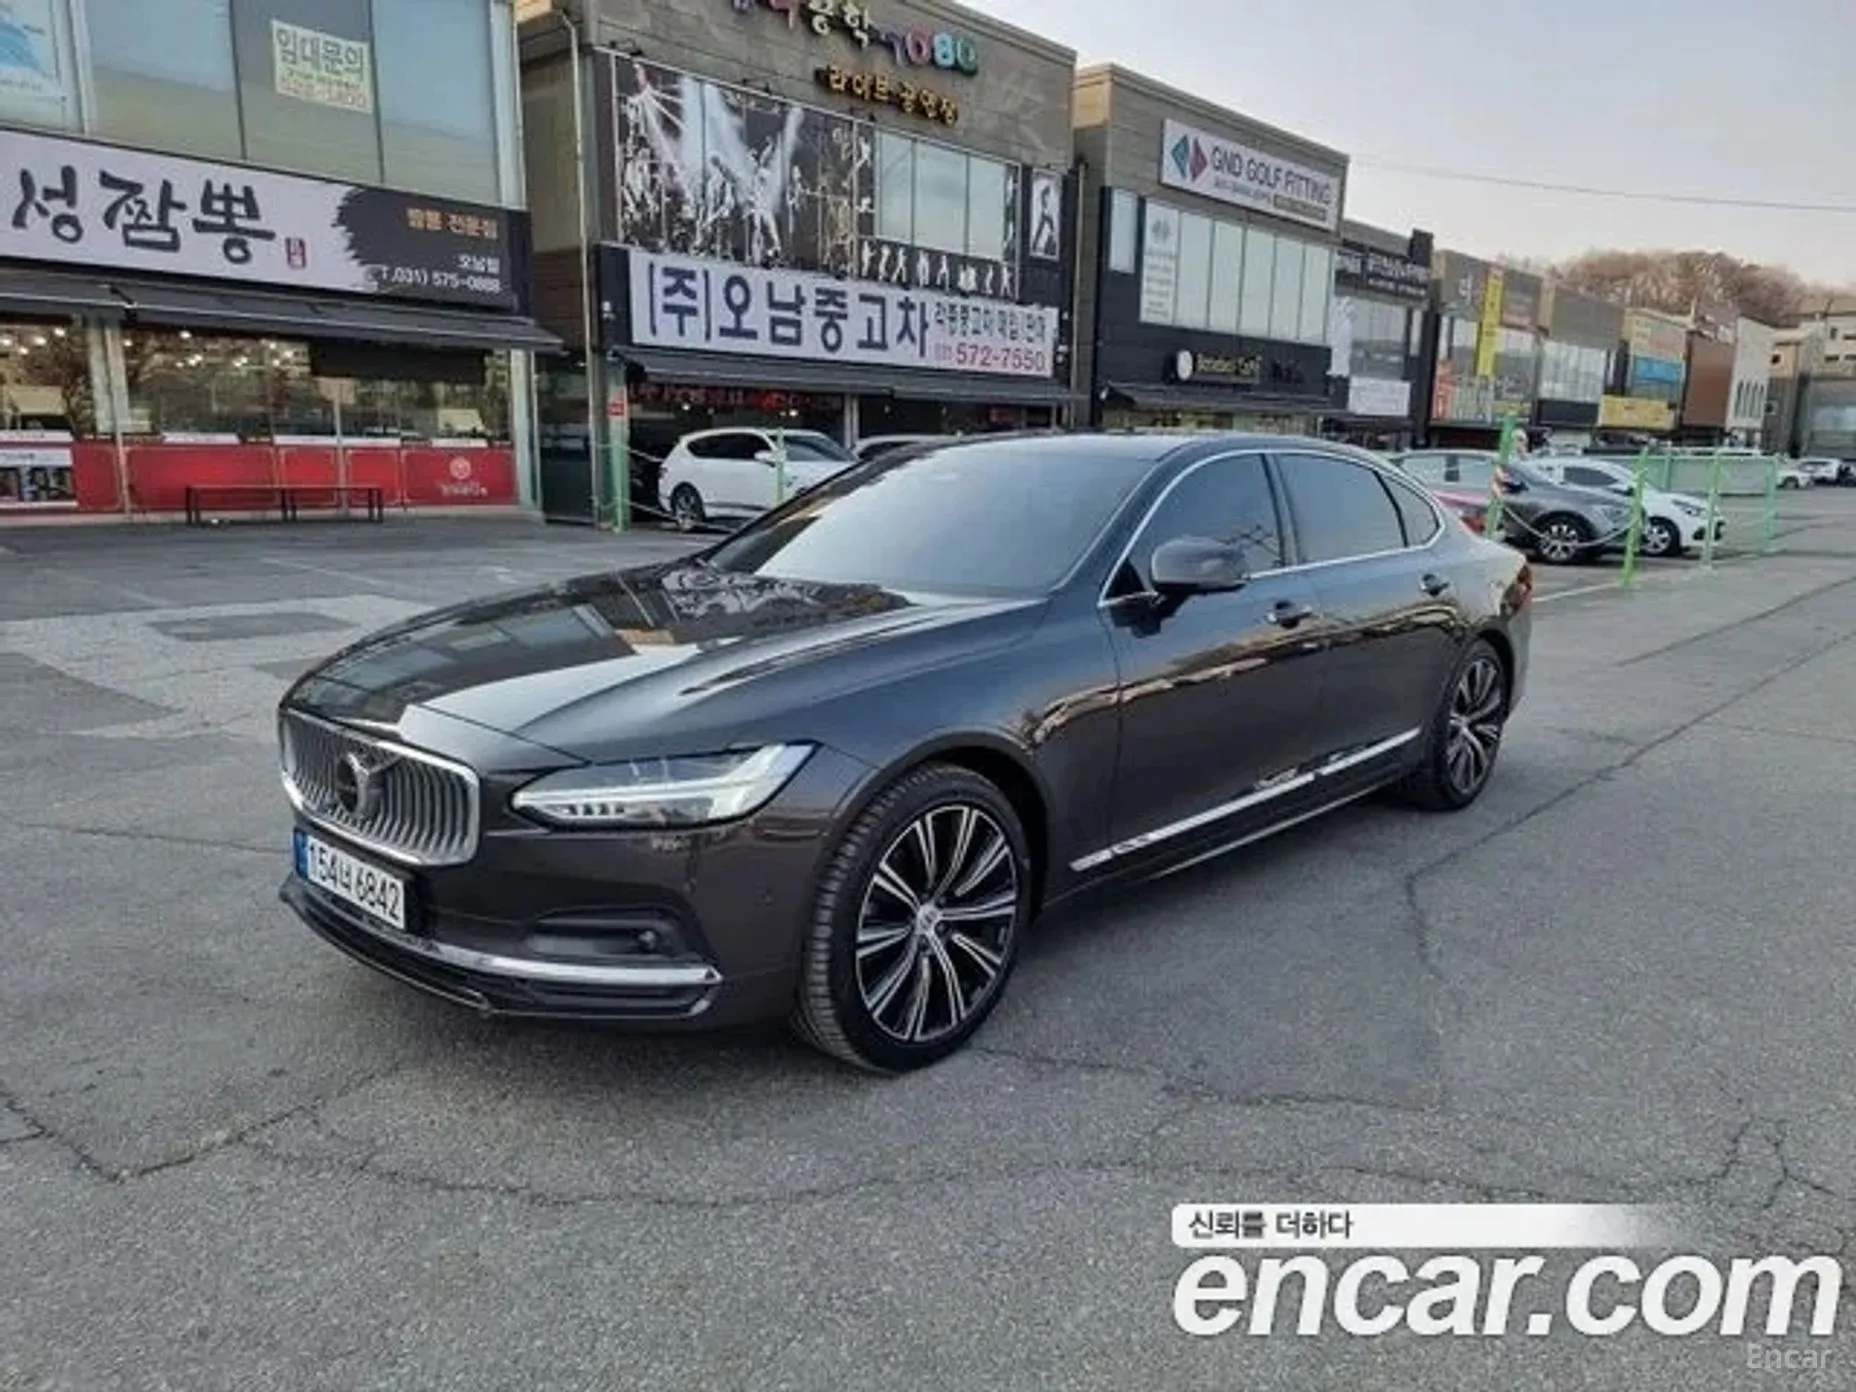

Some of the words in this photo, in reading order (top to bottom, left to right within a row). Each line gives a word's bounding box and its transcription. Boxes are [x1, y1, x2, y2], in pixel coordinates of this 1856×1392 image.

[277, 28, 365, 82] 임대문의
[1247, 159, 1282, 189] GOLF
[1284, 169, 1332, 207] FITTING
[12, 165, 276, 264] 성짬뽕
